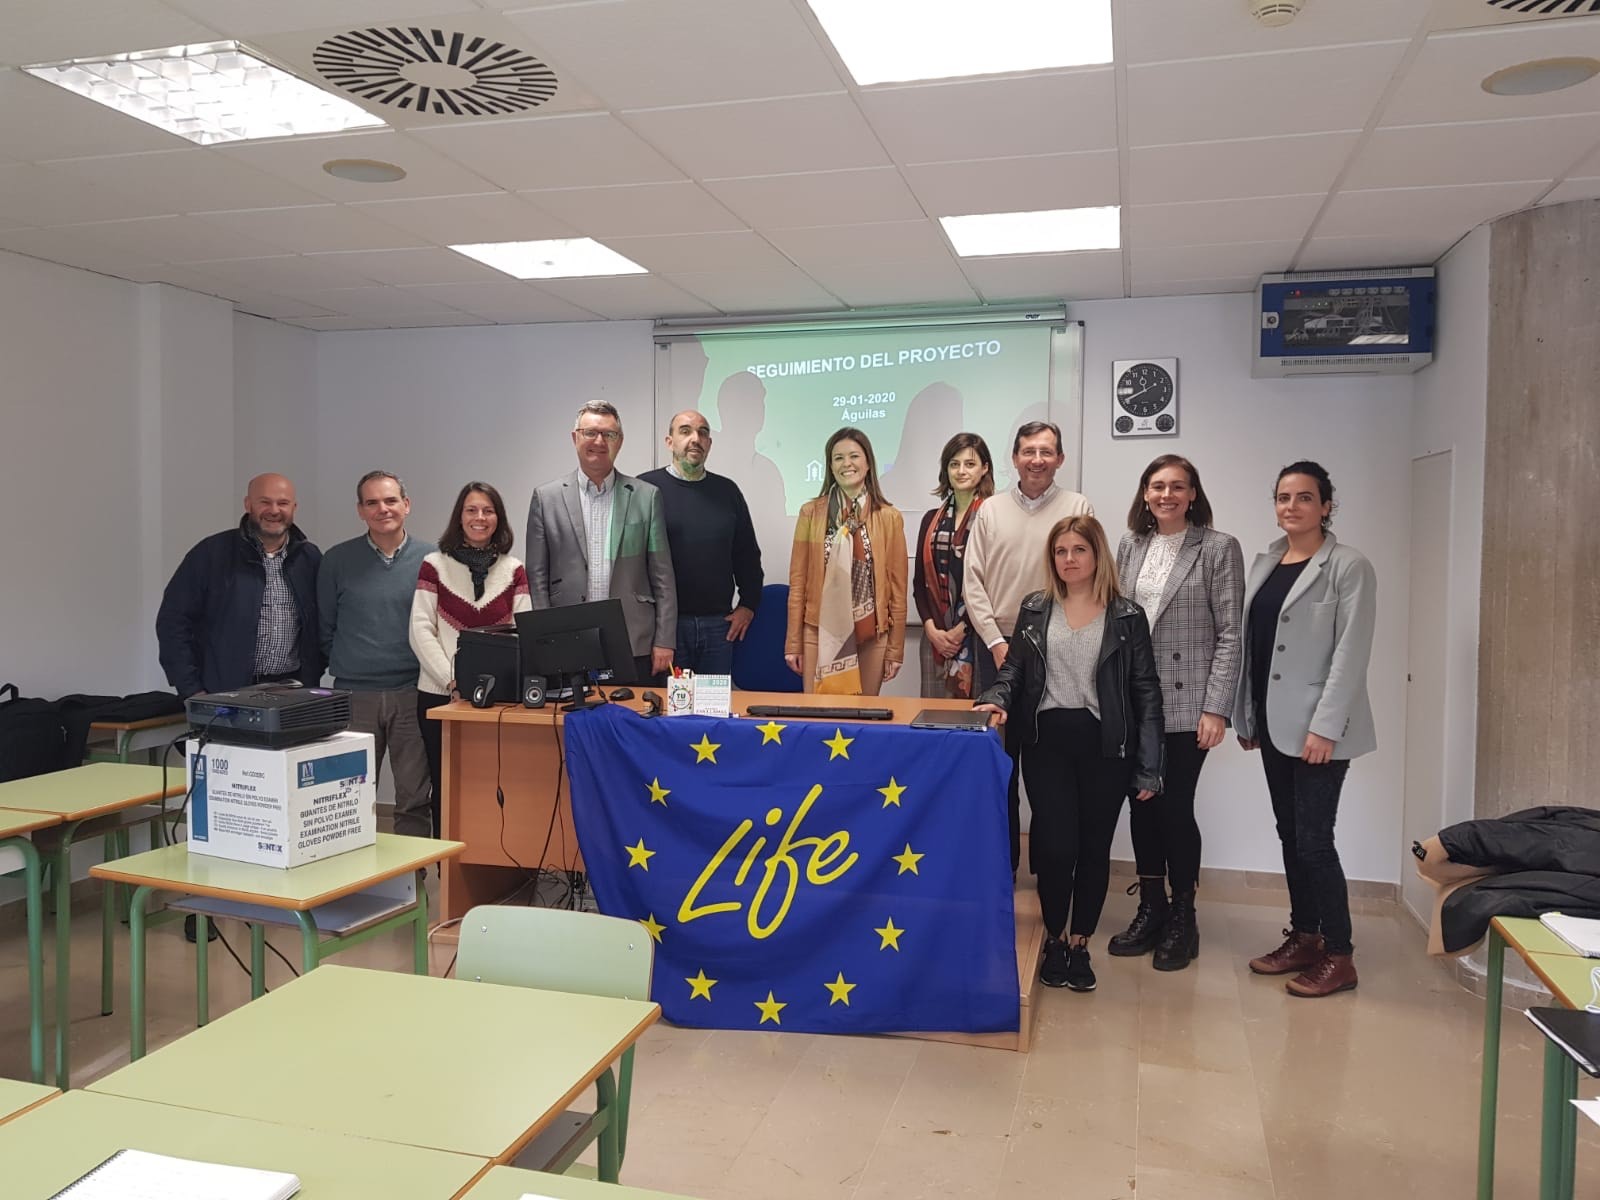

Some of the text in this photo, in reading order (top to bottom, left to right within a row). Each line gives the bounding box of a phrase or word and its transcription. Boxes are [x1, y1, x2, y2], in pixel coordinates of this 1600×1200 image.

[860, 352, 894, 369] DEL
[898, 340, 1001, 365] PROYECTO
[832, 391, 896, 407] 29-01-2020
[841, 407, 886, 422] Águilas
[212, 758, 228, 770] 1000
[313, 792, 347, 805] NITRIFLEX
[300, 805, 327, 818] GUANTES
[338, 798, 358, 809] NITRILO
[314, 814, 333, 825] POLVO
[335, 808, 357, 819] EXAMEN
[300, 817, 360, 838] EXAMINATION NITRILE
[298, 826, 362, 849] GLOVES POWDER FREE
[677, 784, 859, 939] Life
